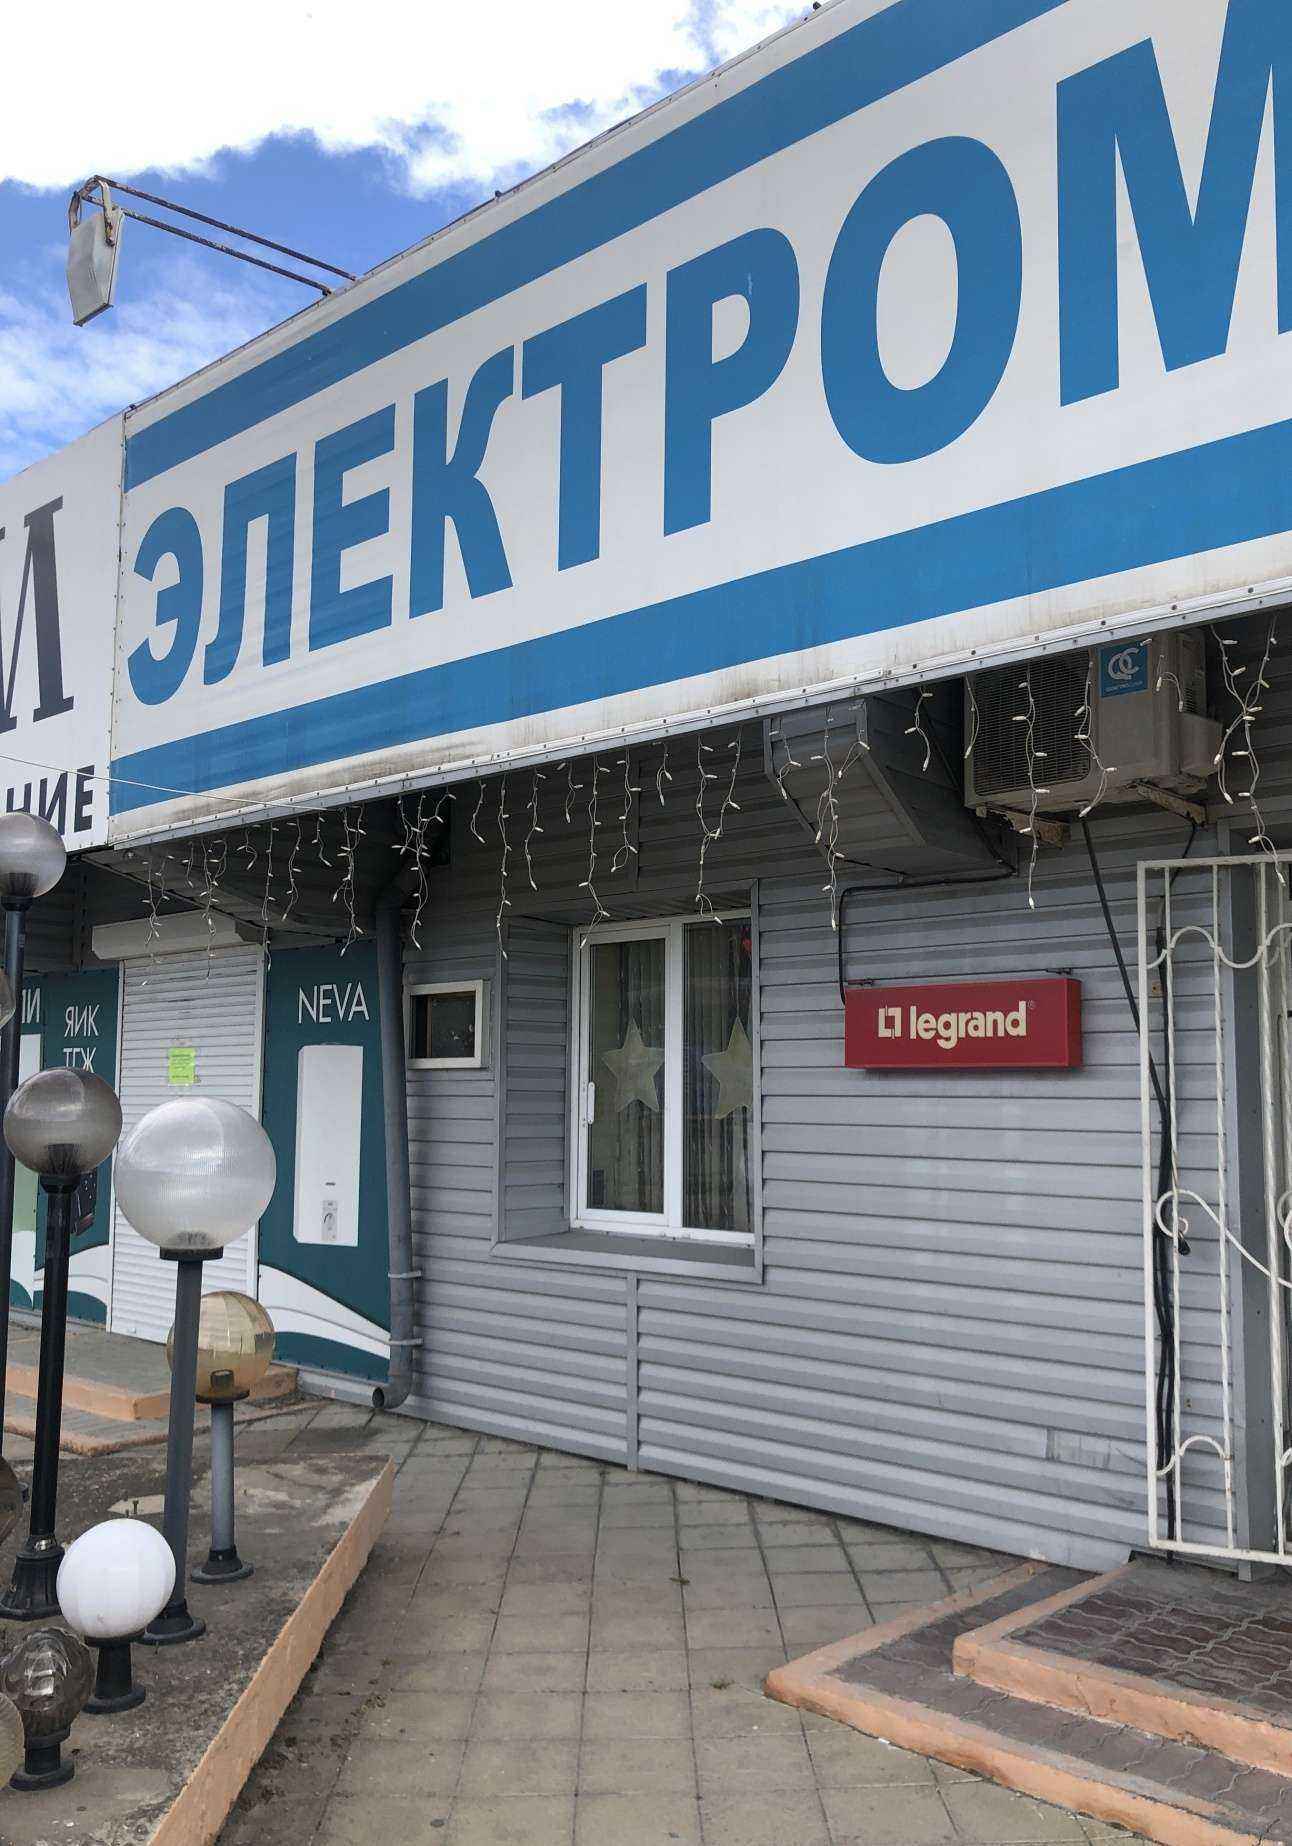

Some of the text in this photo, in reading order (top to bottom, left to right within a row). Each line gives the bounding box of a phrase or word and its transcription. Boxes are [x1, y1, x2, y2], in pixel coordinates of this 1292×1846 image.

[127, 0, 1292, 706] ЭЛЕКТРОМ
[64, 1004, 100, 1038] ЯИК
[298, 981, 370, 1024] NEVA
[909, 1000, 1027, 1049] legrand
